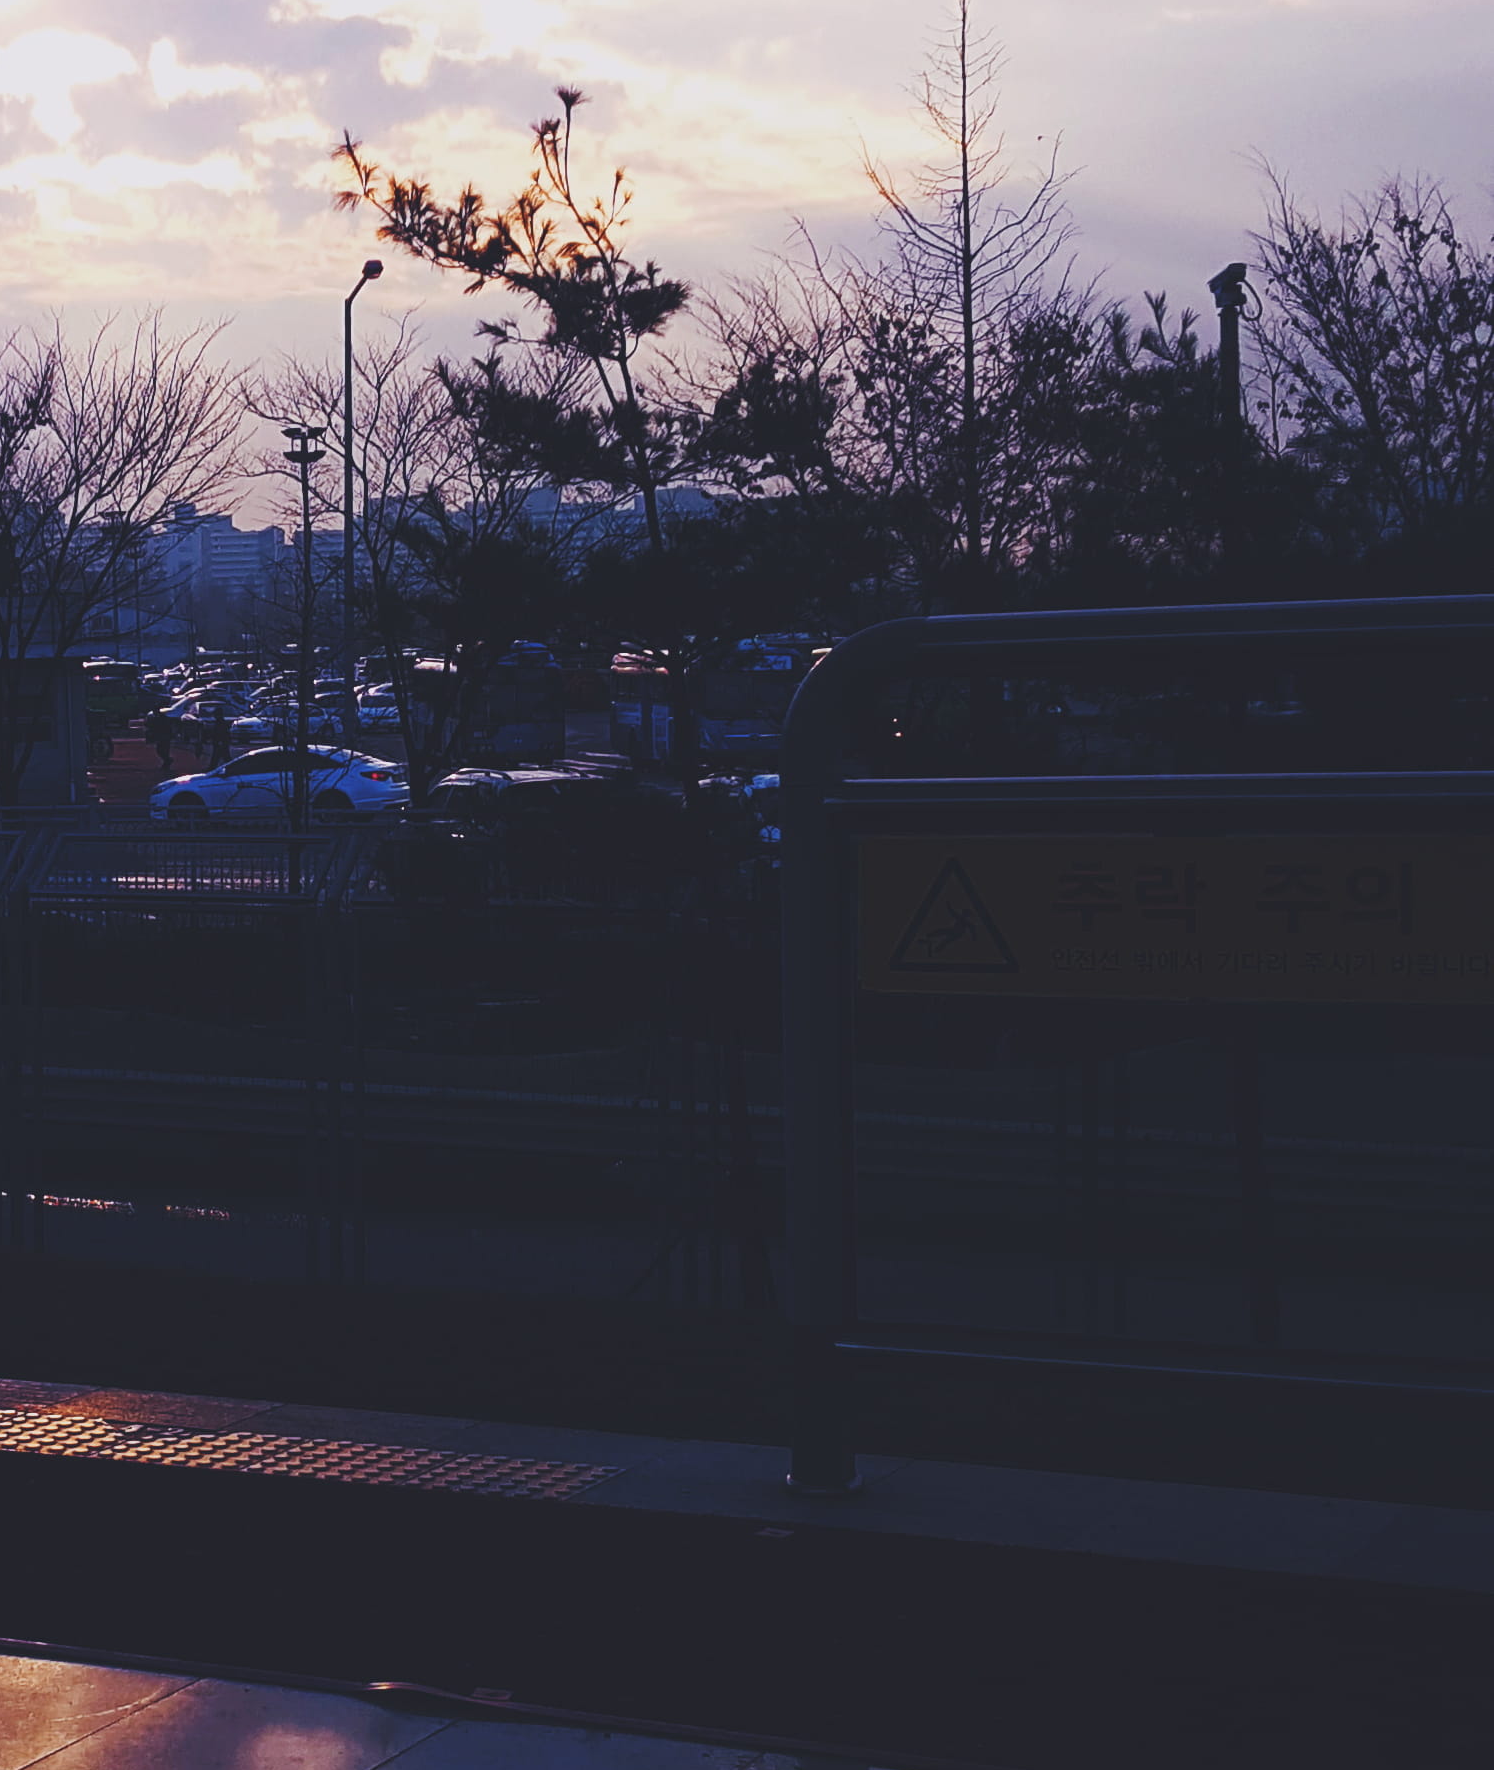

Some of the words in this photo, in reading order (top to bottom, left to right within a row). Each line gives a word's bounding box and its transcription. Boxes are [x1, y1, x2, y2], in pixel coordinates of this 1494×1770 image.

[1050, 862, 1208, 935] 추락
[1255, 861, 1413, 936] 주의
[1051, 948, 1122, 974] 안전선
[1299, 949, 1377, 977] 주시기
